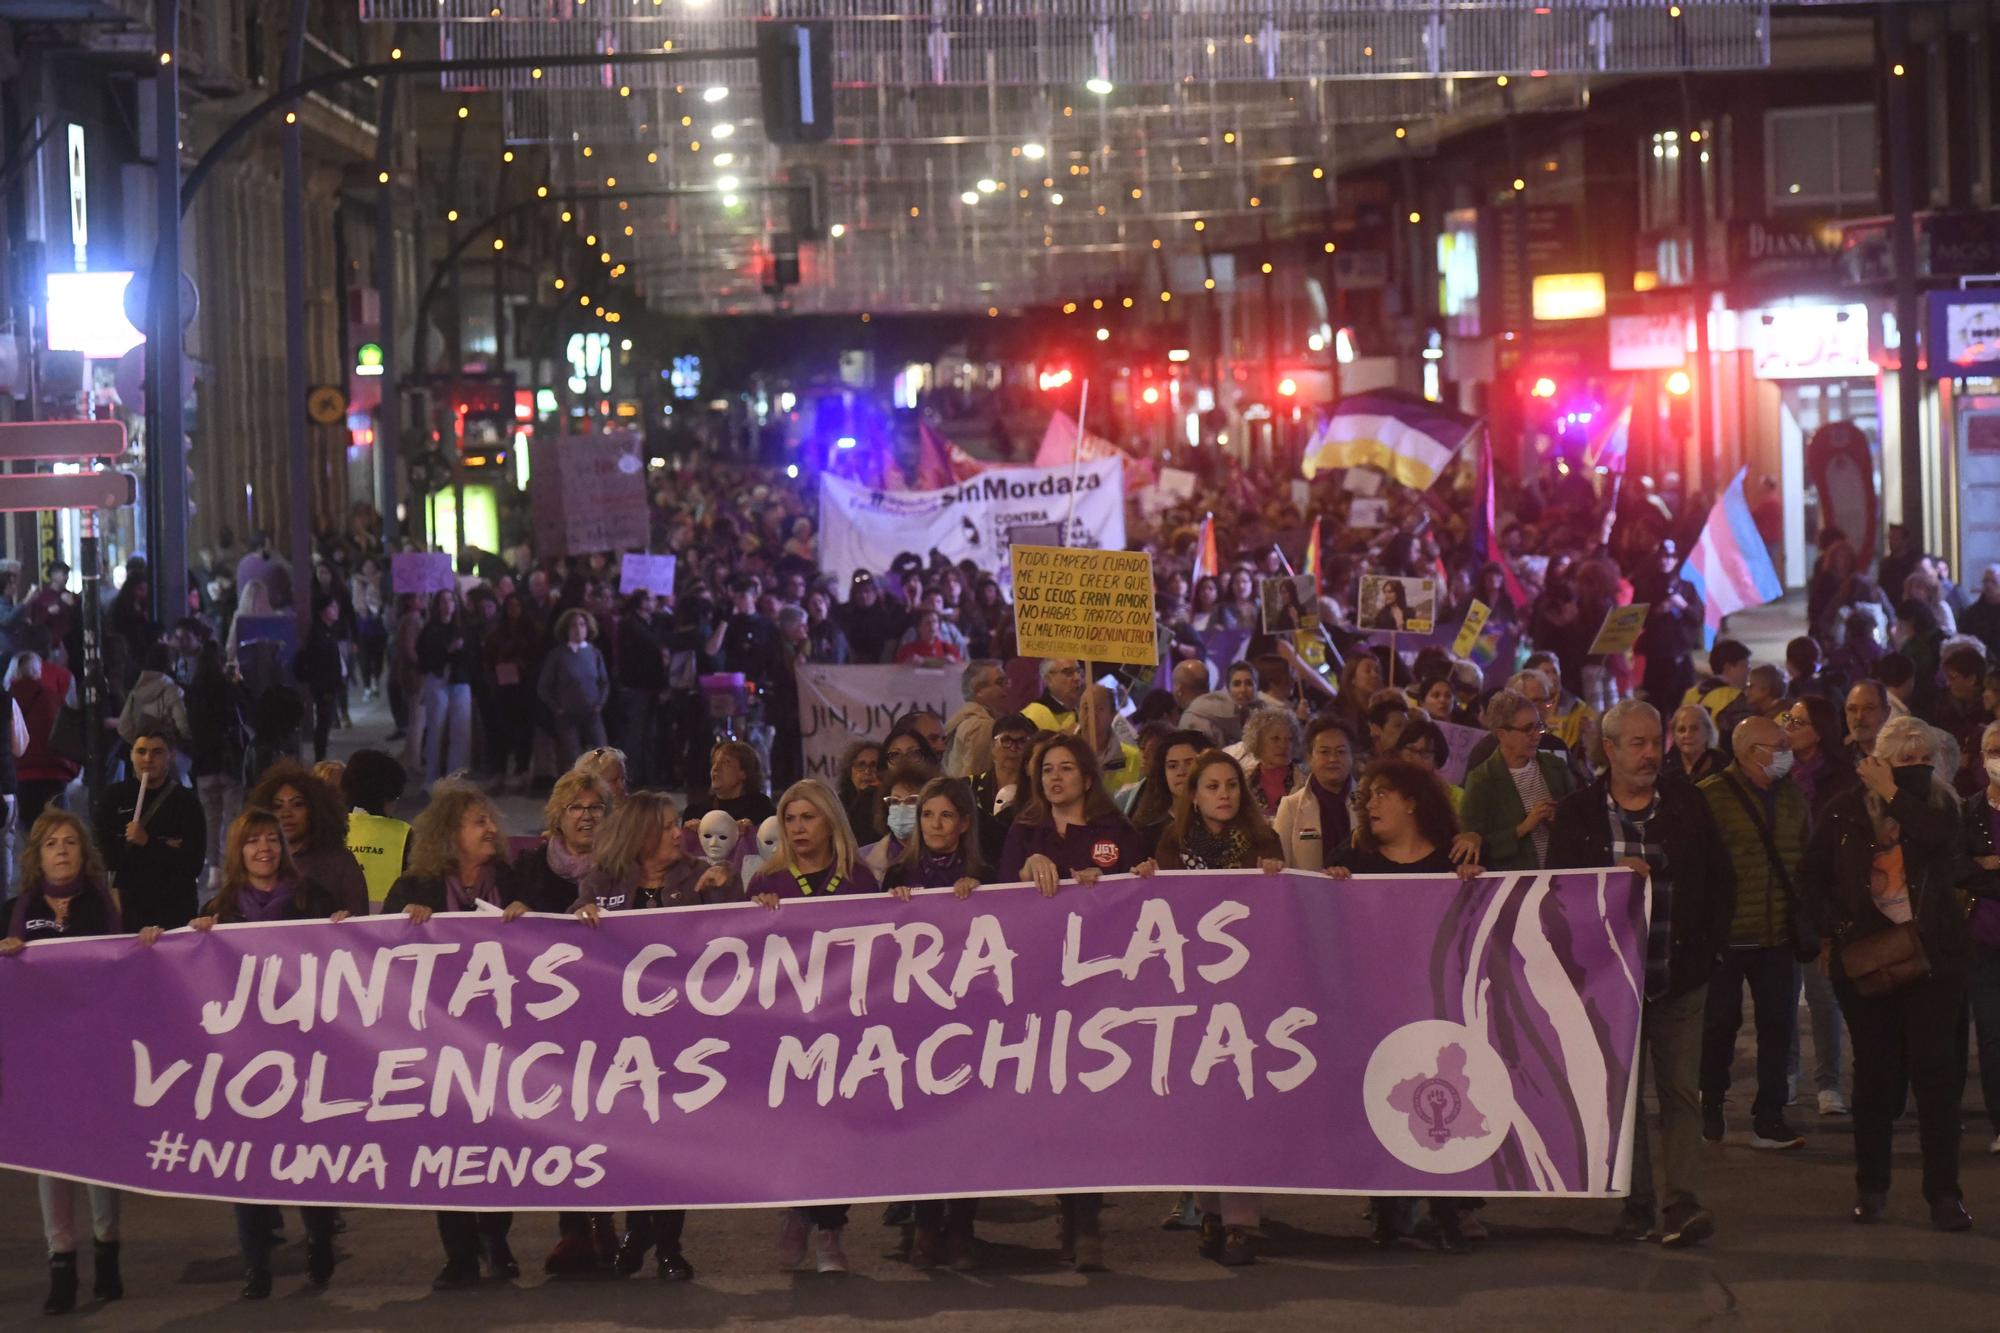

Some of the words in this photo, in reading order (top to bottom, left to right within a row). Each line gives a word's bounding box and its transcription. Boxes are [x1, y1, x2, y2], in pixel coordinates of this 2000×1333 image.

[995, 511, 1048, 525] CONTRA
[1018, 551, 1049, 566] TODO
[1102, 556, 1149, 573] CUANDO
[1017, 569, 1034, 584] ME
[1038, 570, 1073, 586] HIZO
[1079, 573, 1121, 589] CREER
[1016, 585, 1041, 601] SUS
[1079, 590, 1112, 607] ERAN
[1115, 592, 1149, 609] AMOR
[1018, 603, 1039, 619] NO
[1040, 605, 1078, 621] HAGAS
[1082, 608, 1124, 625] TRATOS
[1126, 610, 1152, 625] CON
[1019, 621, 1033, 637] EL
[1033, 622, 1086, 640] MALTRATO
[1094, 843, 1116, 857] UGT
[200, 940, 584, 1034] JUNTAS
[622, 913, 1019, 1018] CONTRA
[1060, 897, 1251, 994] LAS
[132, 1035, 731, 1125] VIOLENCIAS
[768, 1001, 1318, 1111] MACHISTAS
[145, 1130, 253, 1182] #NI
[270, 1142, 389, 1191] UNA
[409, 1142, 609, 1189] MENOS
